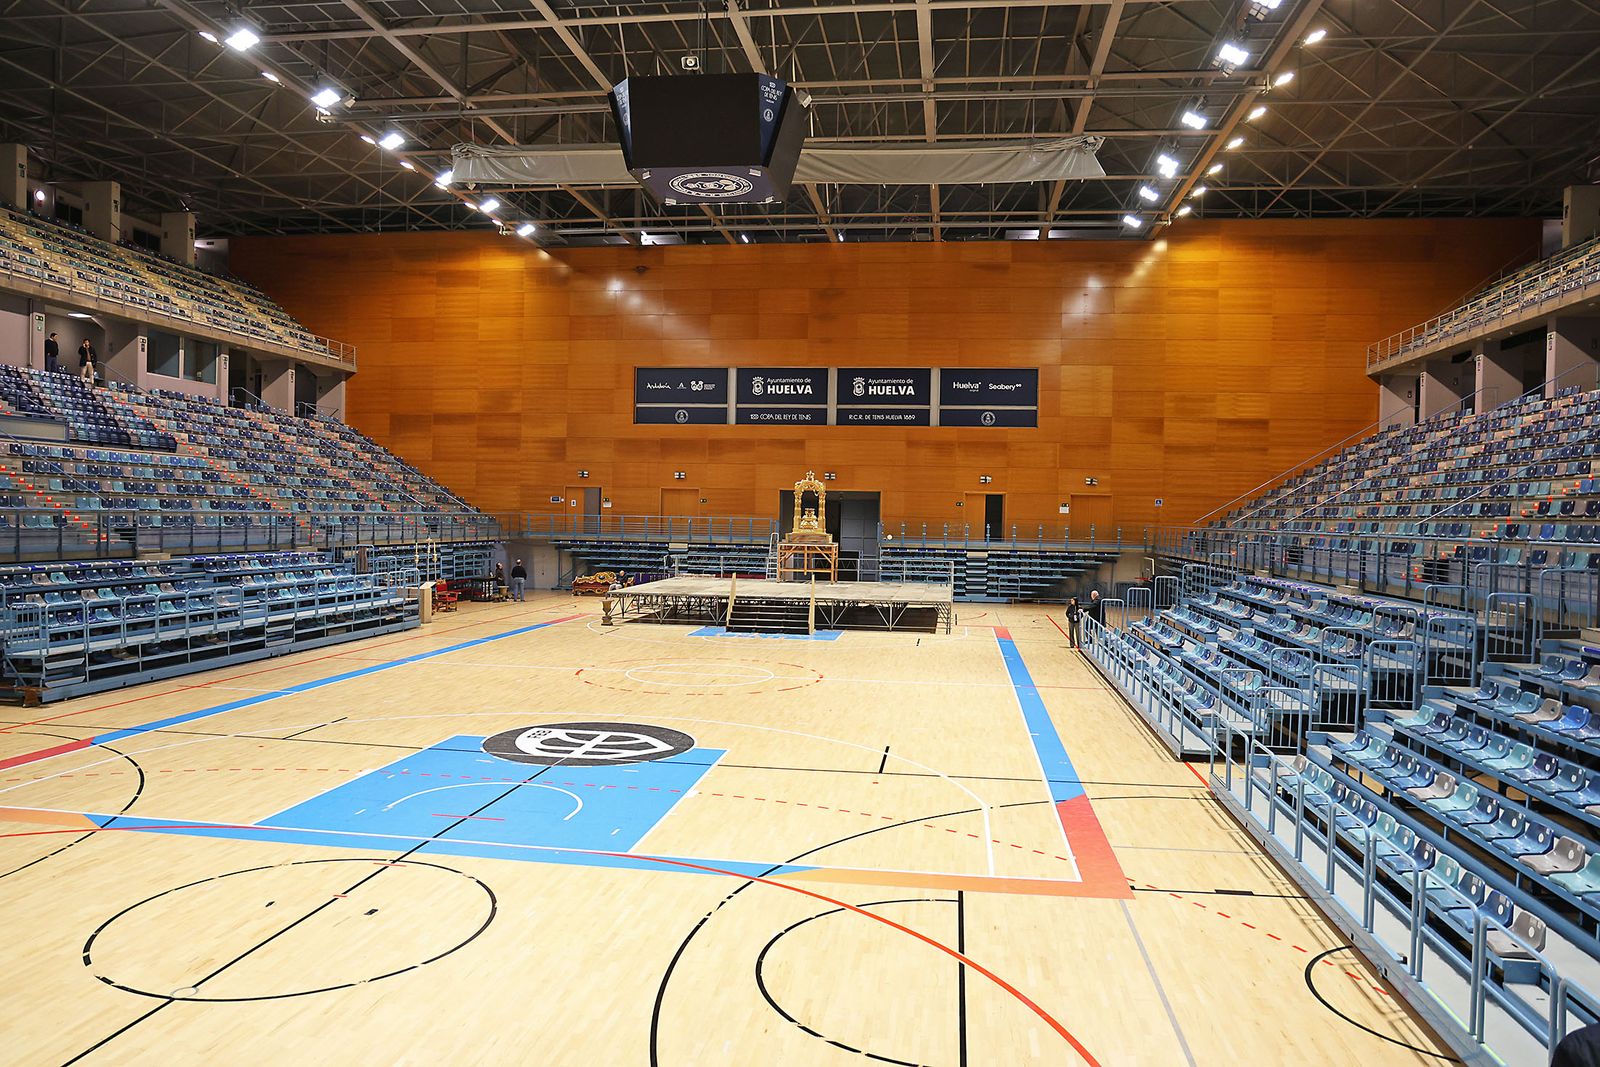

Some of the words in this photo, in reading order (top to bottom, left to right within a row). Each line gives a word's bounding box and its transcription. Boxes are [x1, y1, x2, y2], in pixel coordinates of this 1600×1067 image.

[767, 385, 812, 394] HUELVA
[868, 386, 915, 395] HUELVA
[988, 383, 1016, 391] Seabery
